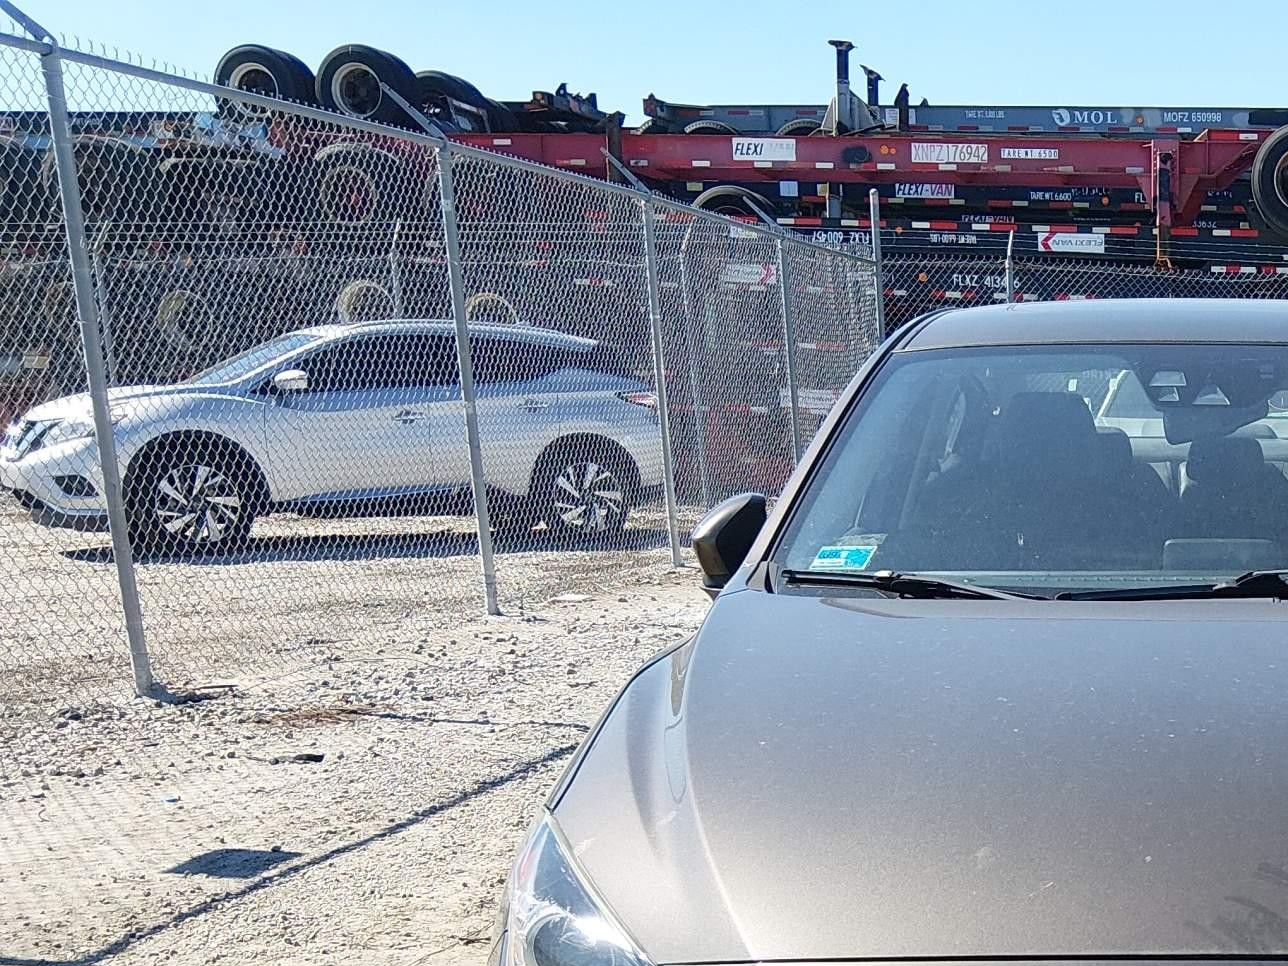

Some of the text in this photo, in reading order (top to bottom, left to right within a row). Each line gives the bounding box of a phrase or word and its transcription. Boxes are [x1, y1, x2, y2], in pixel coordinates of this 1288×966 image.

[1073, 110, 1118, 125] MOL
[1163, 111, 1222, 122] MOFZ 650998
[734, 142, 764, 156] FLEXI
[1002, 149, 1022, 158] TARE
[896, 184, 954, 197] FLEXI-VAN
[953, 274, 1020, 289] FLXZ 41346
